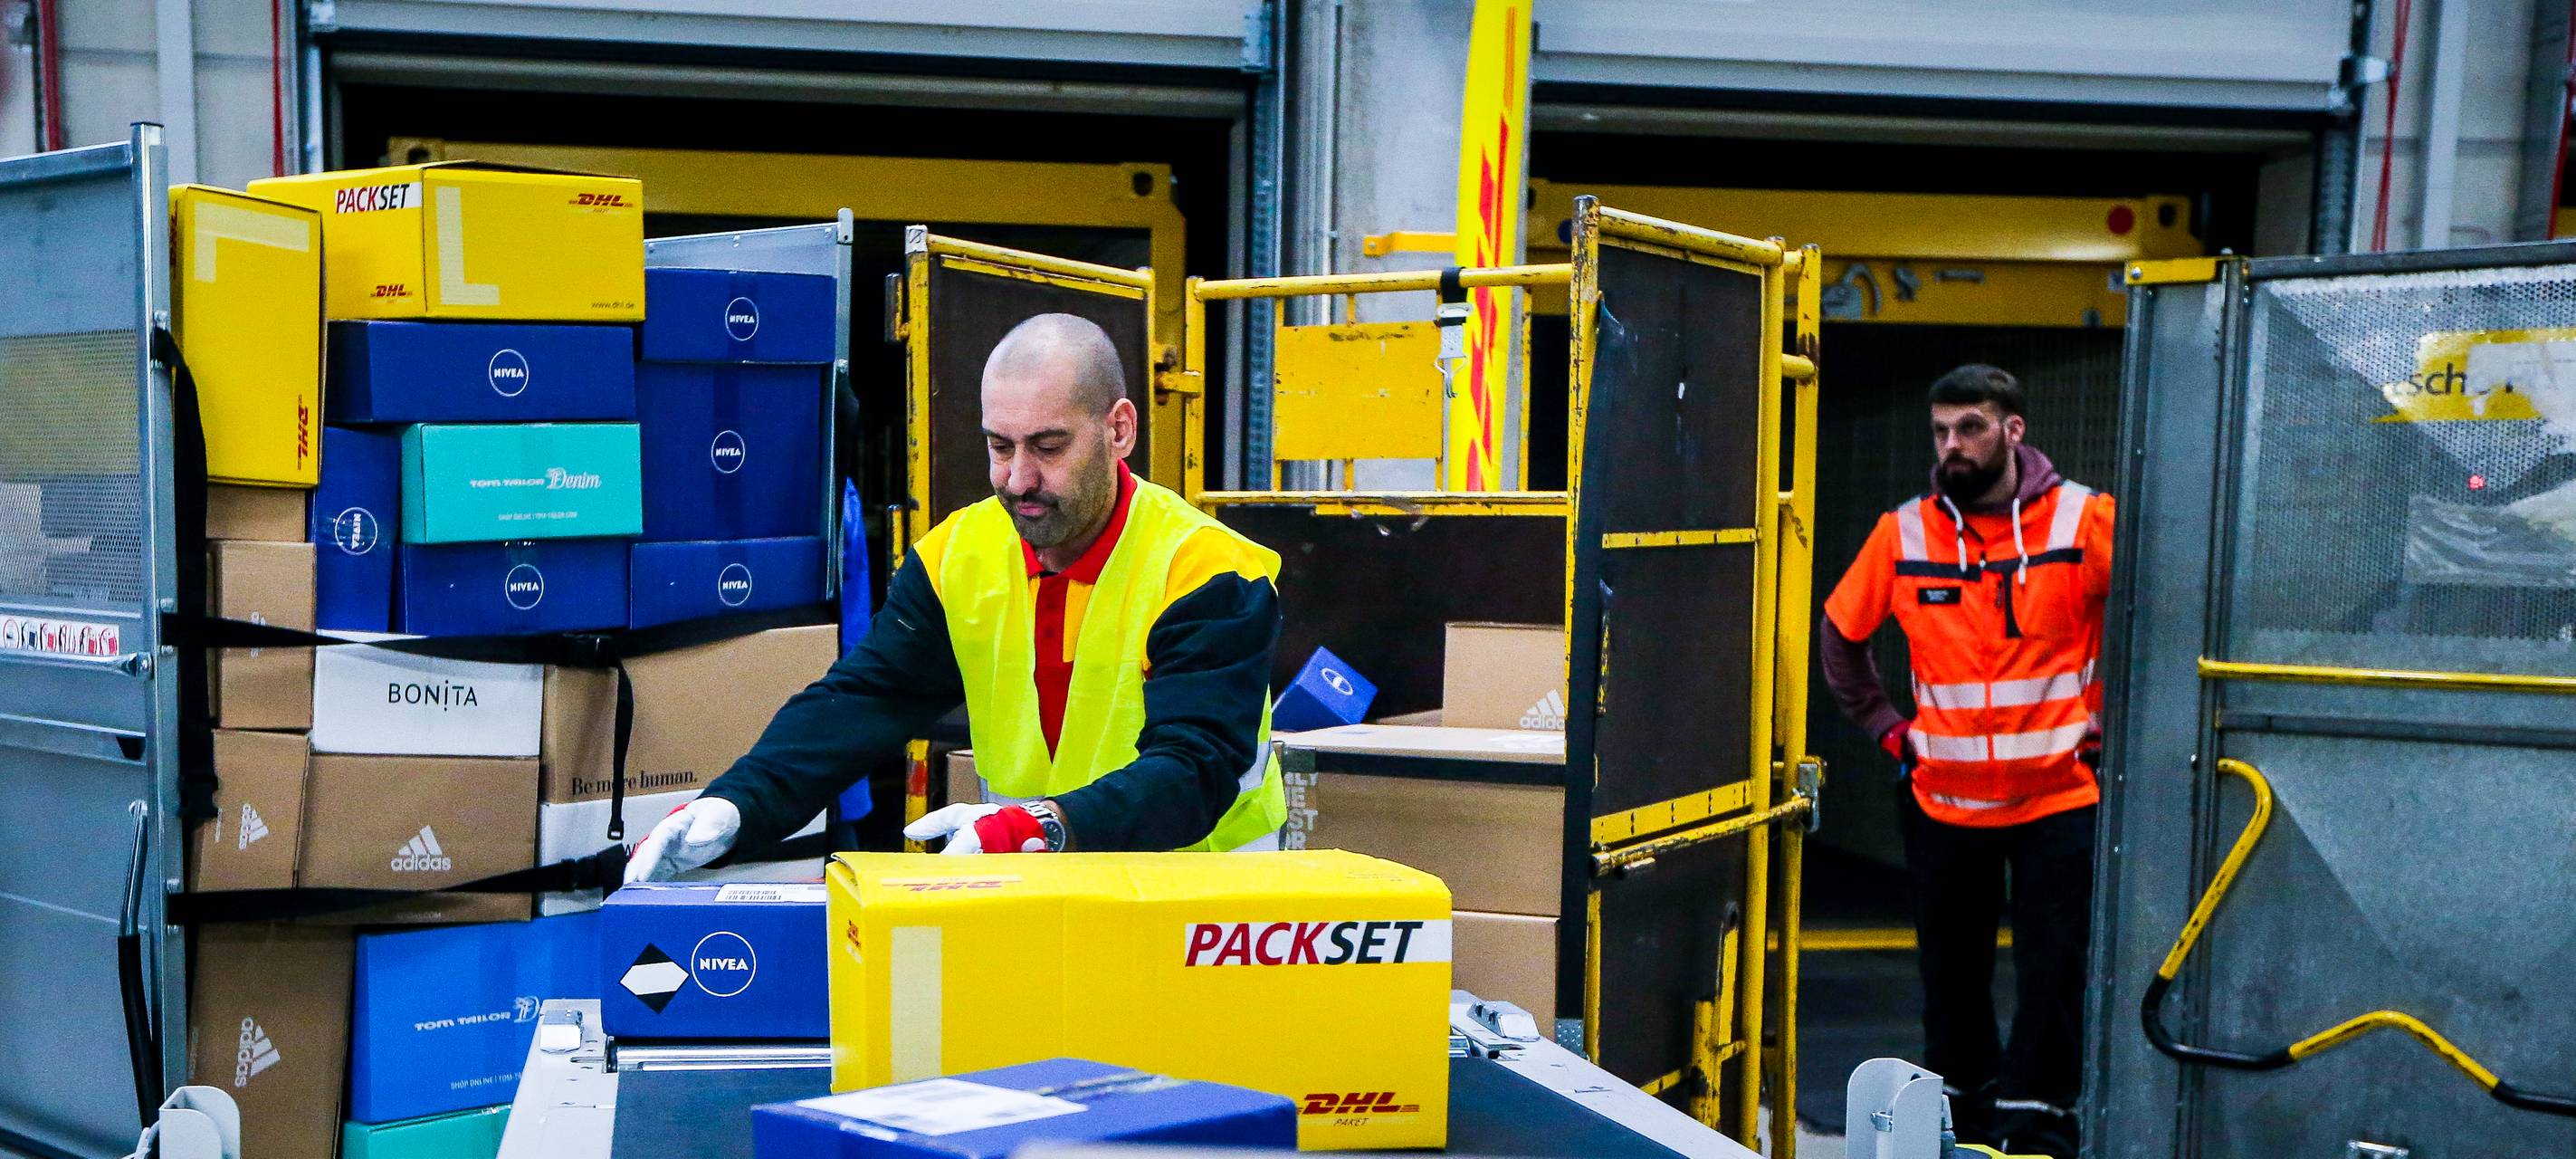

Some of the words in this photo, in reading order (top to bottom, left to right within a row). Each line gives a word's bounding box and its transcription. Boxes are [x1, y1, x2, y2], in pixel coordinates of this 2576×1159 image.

[336, 183, 410, 214] PACKSET
[577, 193, 625, 207] DHL
[376, 283, 406, 297] DHL
[1466, 114, 1509, 491] HL
[730, 314, 755, 323] NIVEA
[493, 368, 525, 378] NIVEA
[298, 404, 309, 457] DHL
[715, 447, 741, 457] NIVEA
[546, 466, 602, 490] Denim
[351, 512, 362, 550] NIVEA
[510, 581, 539, 592] NIVEA
[722, 580, 749, 590] NIVEA
[1519, 713, 1565, 729] adida
[572, 777, 594, 796] Be
[640, 770, 698, 789] human.
[238, 803, 252, 849] adidas
[390, 854, 452, 871] adidas
[1184, 921, 1425, 967] PACKSET
[699, 957, 749, 971] NIVEA
[414, 1019, 455, 1031] TOM
[456, 1011, 511, 1026] TAILOR
[234, 1016, 254, 1087] adidas
[1302, 1091, 1402, 1115] DHL
[1333, 1117, 1369, 1127] PAKET
